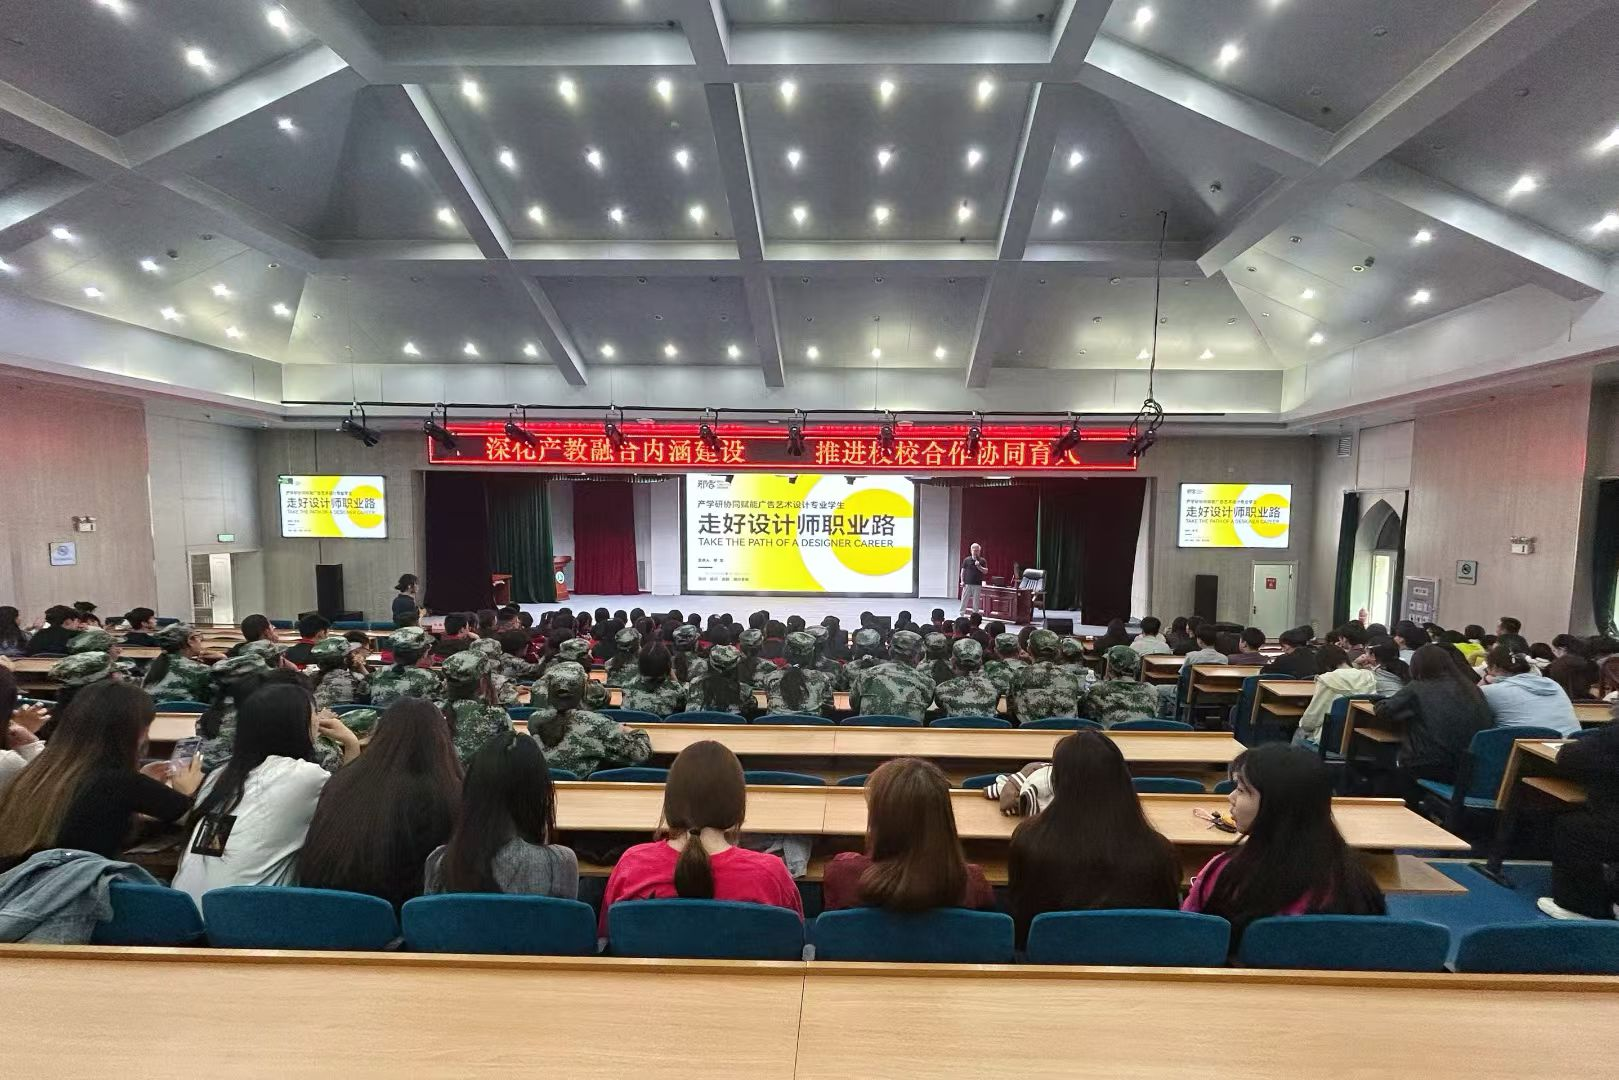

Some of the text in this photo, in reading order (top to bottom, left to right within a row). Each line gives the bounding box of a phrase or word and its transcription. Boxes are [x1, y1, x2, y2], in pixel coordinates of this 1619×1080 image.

[287, 497, 376, 509] 走好设计师职业路
[697, 500, 845, 510] 产学研协同赋能广告艺术设计专业学生
[1186, 506, 1280, 518] 走好设计师职业路
[698, 513, 895, 536] 走好设计师职业路
[698, 537, 894, 548] TAKE THE PATH OF A DESIGNER CAREER
